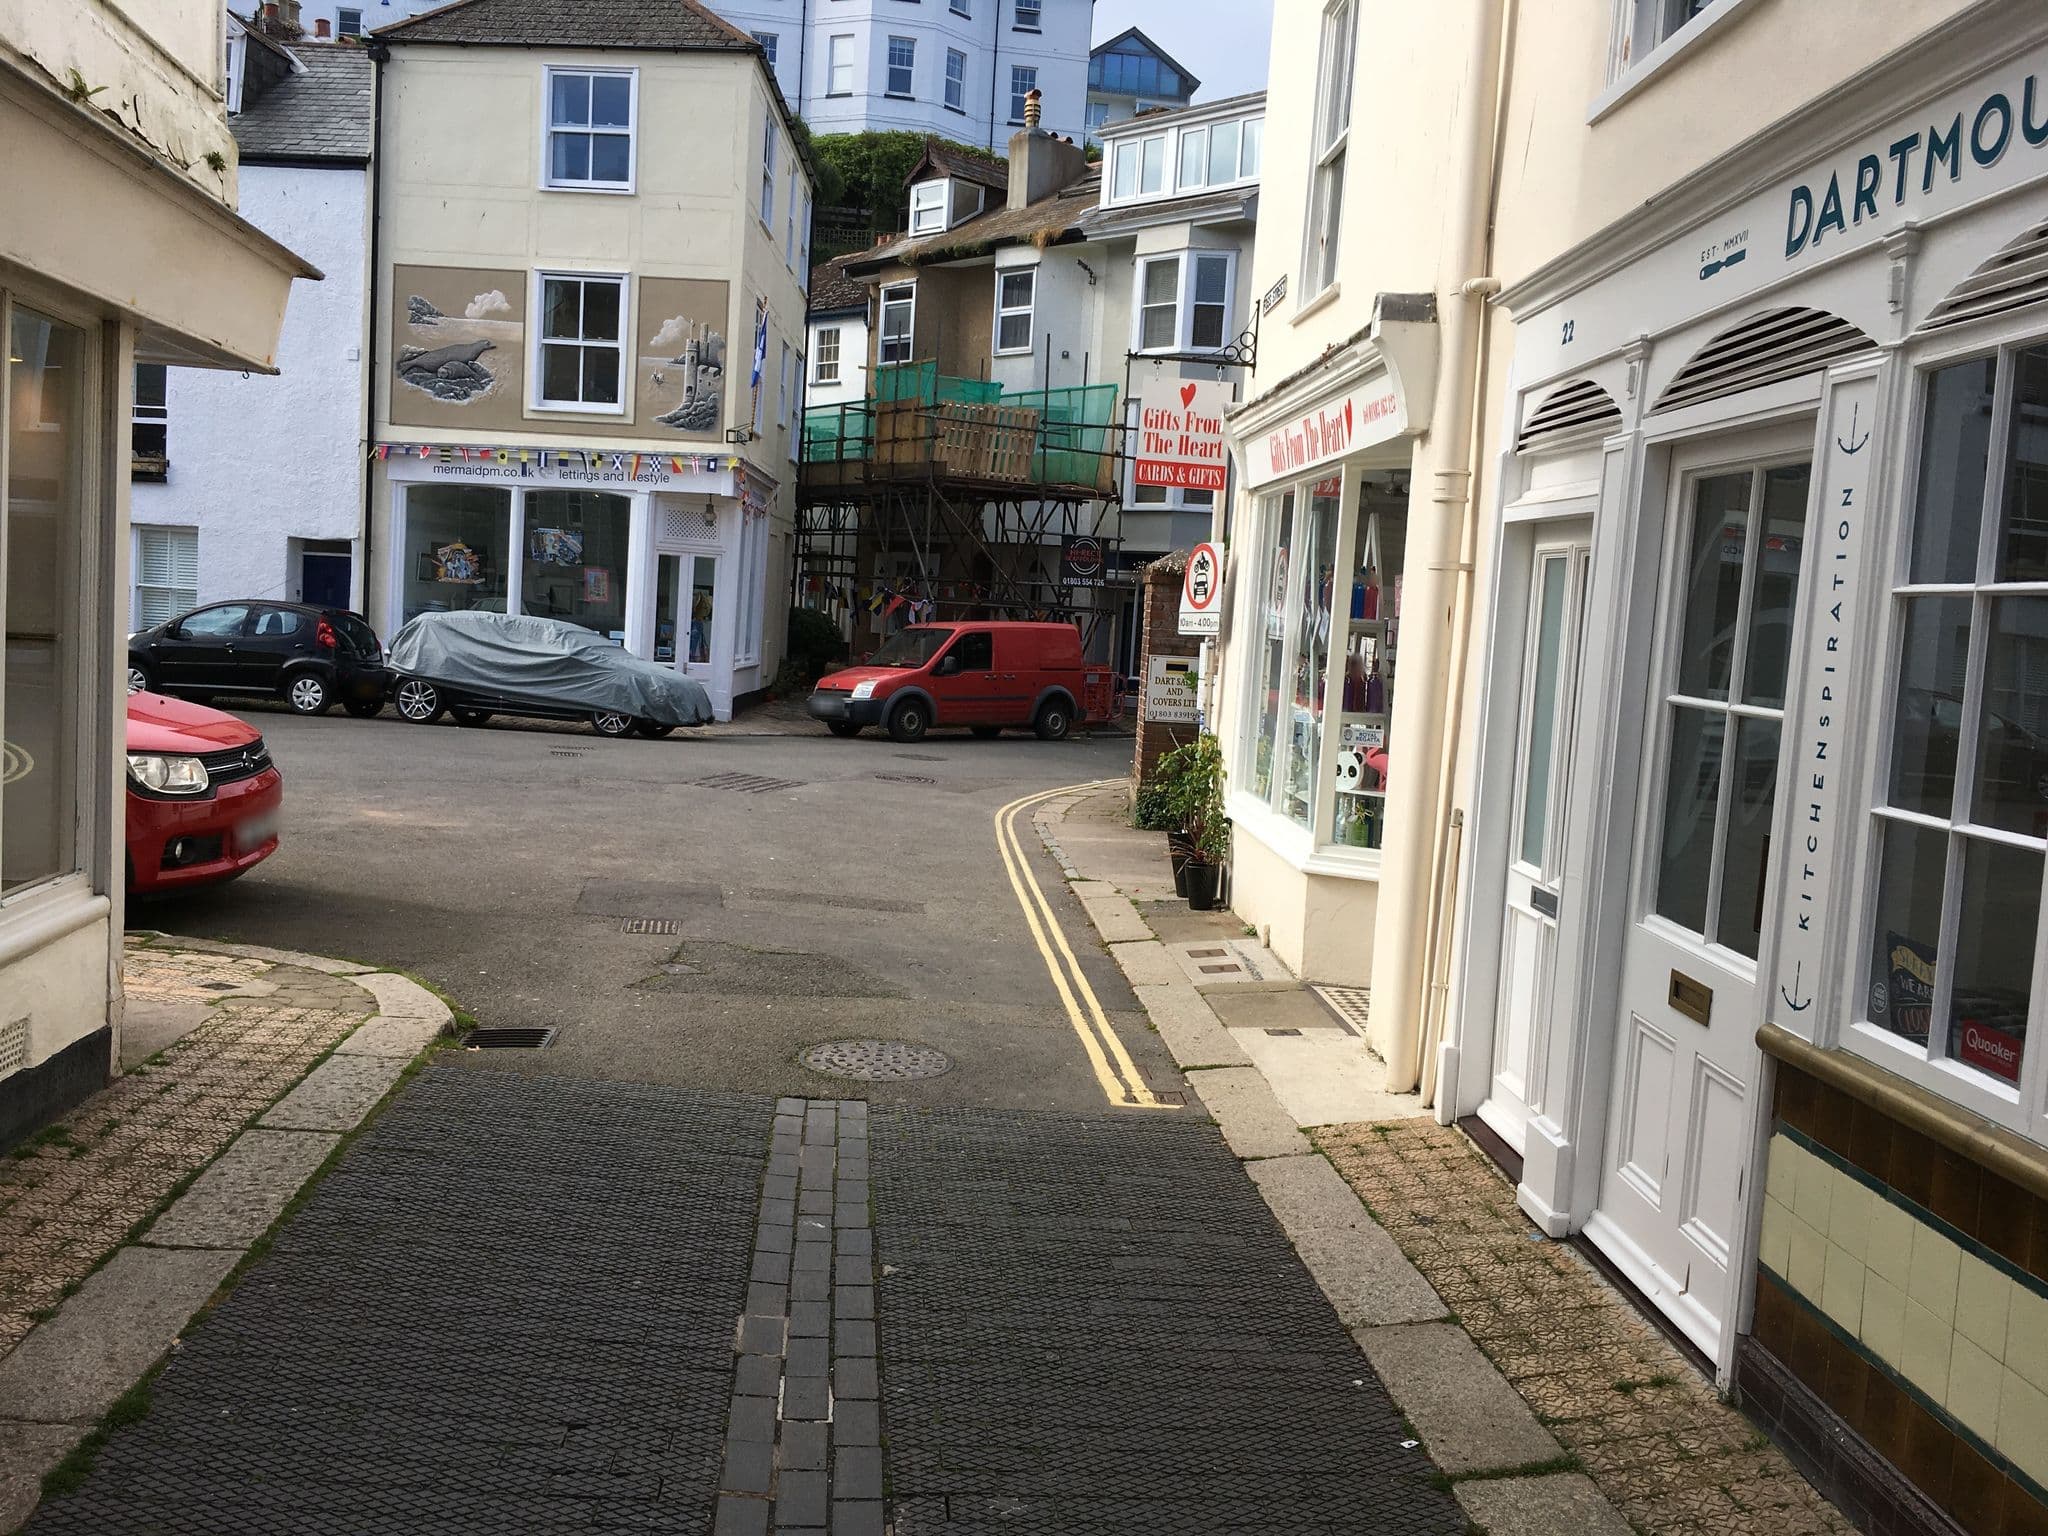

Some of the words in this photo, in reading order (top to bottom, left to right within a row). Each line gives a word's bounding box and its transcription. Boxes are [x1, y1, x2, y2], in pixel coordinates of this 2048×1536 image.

[1724, 229, 1749, 251] MMXVII
[1561, 319, 1575, 346] 22
[1143, 407, 1180, 431] Gifts
[1144, 431, 1173, 455] The
[1178, 435, 1224, 459] Heart
[1269, 433, 1286, 475] Gifts
[1285, 428, 1305, 470] From
[1302, 418, 1319, 463] The
[1319, 408, 1346, 457] Heart
[433, 465, 535, 478] mermaidpm.co.k
[559, 469, 600, 483] lettings
[603, 471, 624, 482] and
[1138, 463, 1174, 483] CARDS
[1176, 467, 1186, 484] &
[1188, 467, 1222, 486] GIFTS
[1155, 676, 1176, 686] DART
[1166, 687, 1183, 696] AND
[1152, 697, 1182, 707] COVERS
[1798, 487, 1854, 932] KITCHENSPIRATION
[1149, 710, 1172, 719] 01803
[1966, 1028, 2016, 1063] Quooker
